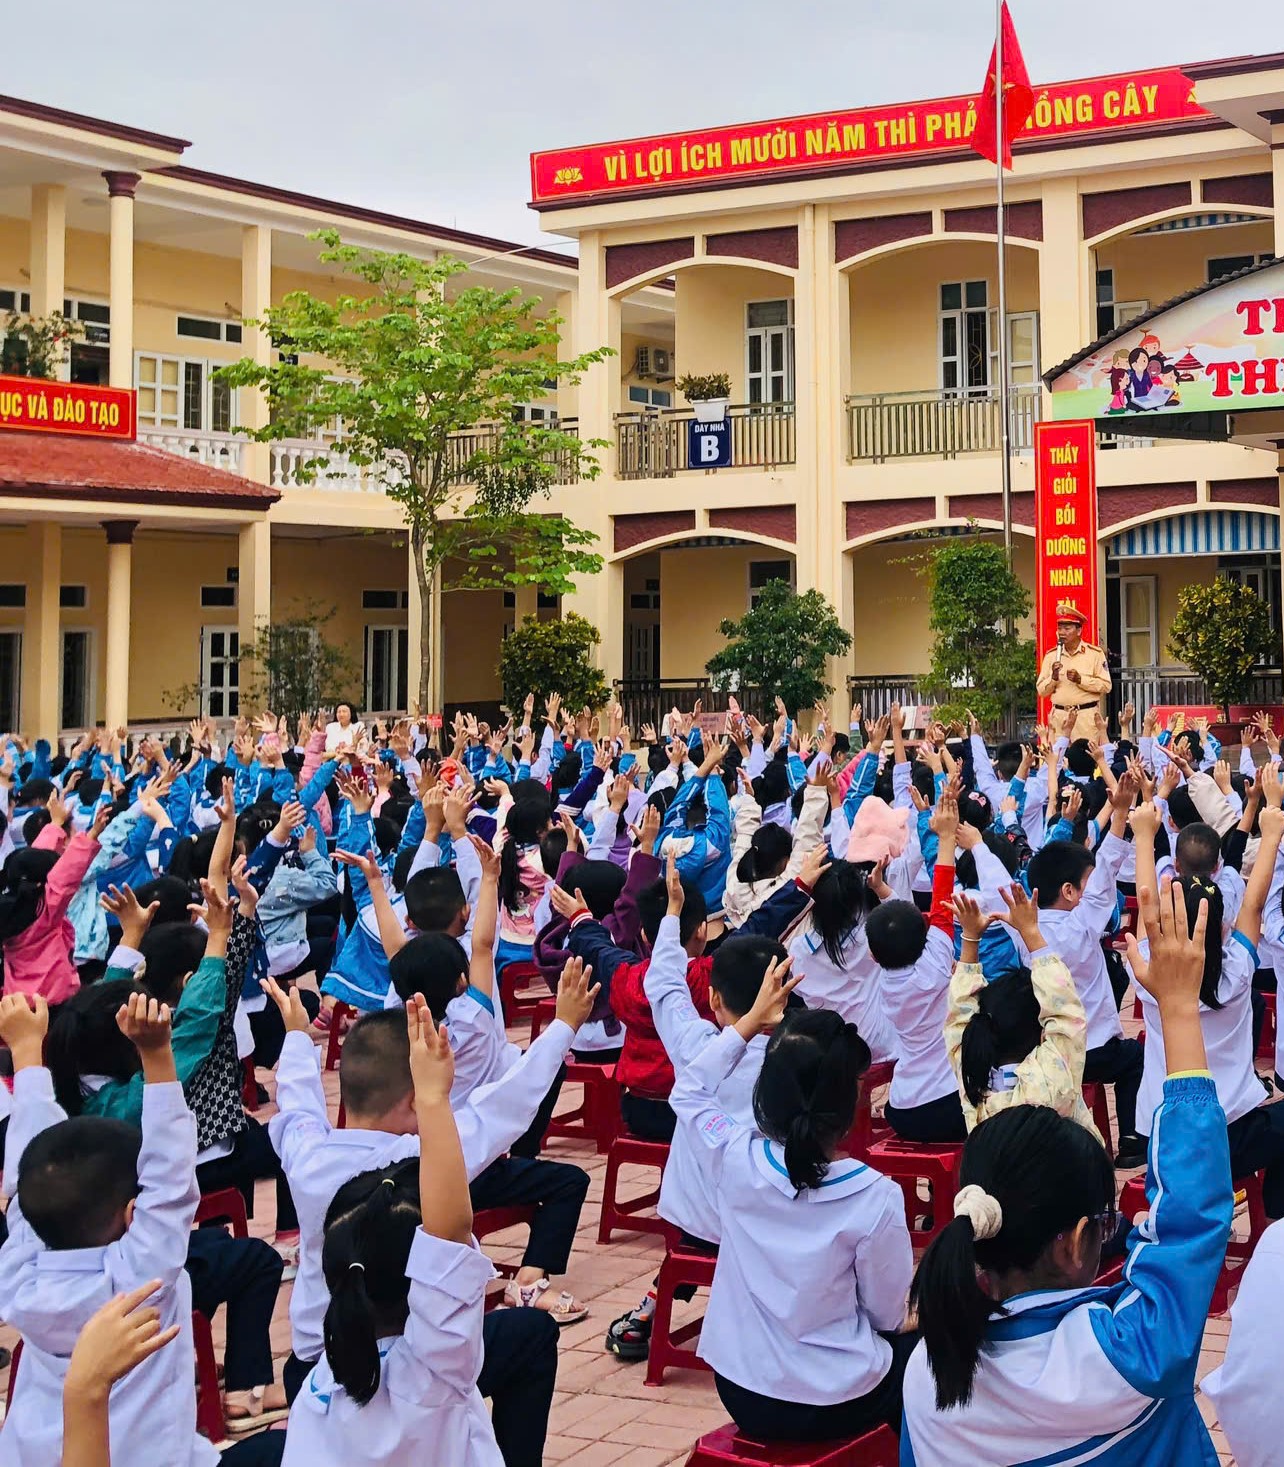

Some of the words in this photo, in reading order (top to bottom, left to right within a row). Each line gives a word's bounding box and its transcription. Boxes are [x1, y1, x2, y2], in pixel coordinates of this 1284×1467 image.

[604, 147, 628, 181] VÌ
[635, 147, 673, 181] LỢI
[681, 141, 722, 172] ÍCH
[731, 127, 796, 166] MƯỜI
[805, 122, 866, 156] NĂM
[874, 112, 917, 147] THÌ
[925, 101, 977, 142] PHẢ
[1025, 90, 1093, 130] ỒNG
[1103, 83, 1159, 119] CÂY
[0, 391, 23, 422] ỤC
[28, 390, 49, 420] VÀ
[53, 393, 86, 424] ĐÀO
[90, 400, 119, 431] TẠO
[701, 435, 720, 462] B
[1046, 534, 1086, 556] DƯỠNG
[1049, 564, 1083, 587] NHÂN
